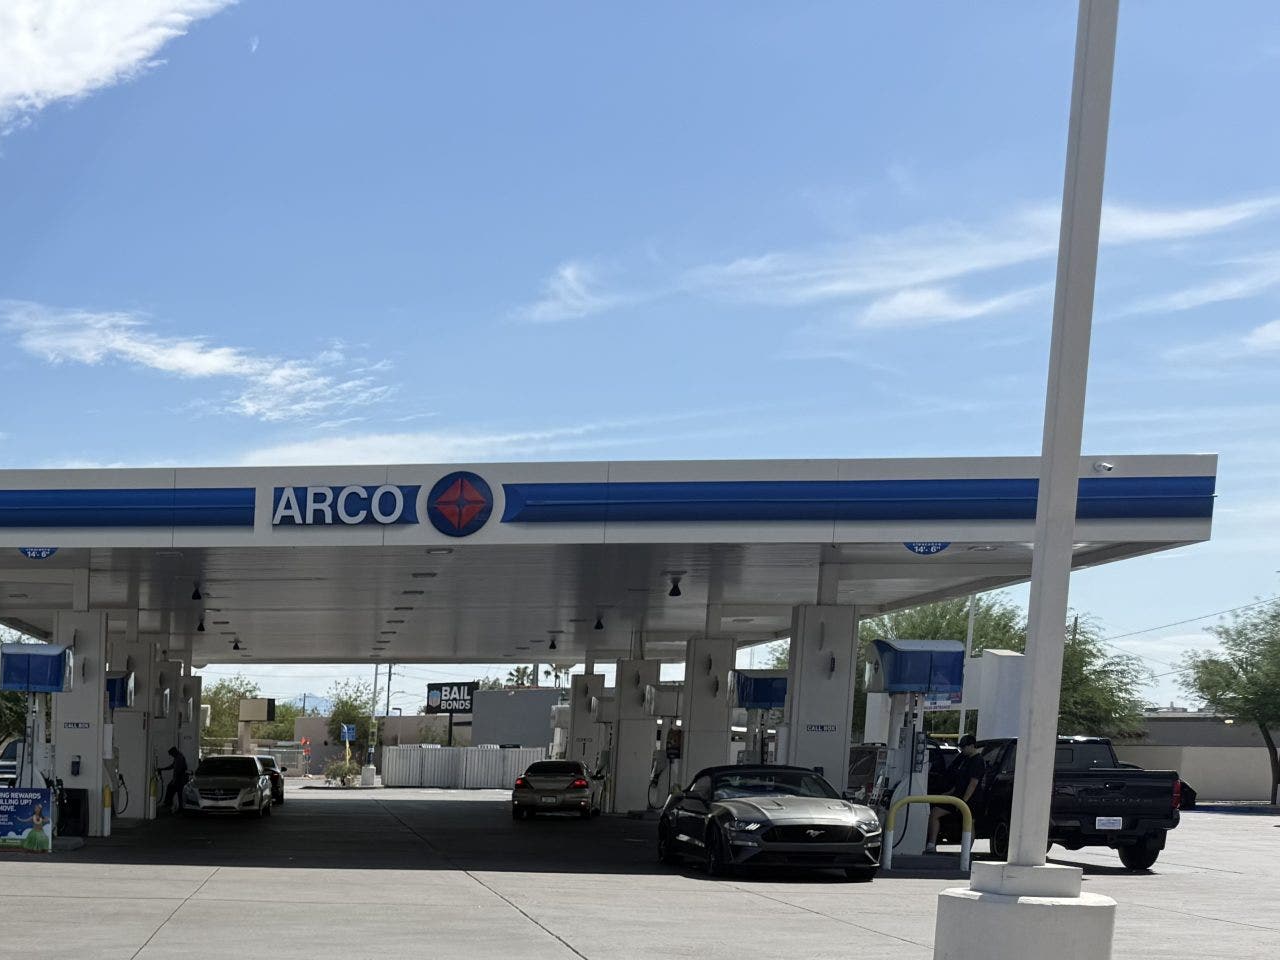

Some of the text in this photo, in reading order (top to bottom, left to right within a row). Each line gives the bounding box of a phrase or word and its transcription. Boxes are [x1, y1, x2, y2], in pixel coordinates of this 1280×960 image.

[272, 484, 404, 525] ARCO
[441, 686, 470, 700] BAIL
[441, 700, 470, 710] BONDS
[11, 792, 41, 800] REWARDS
